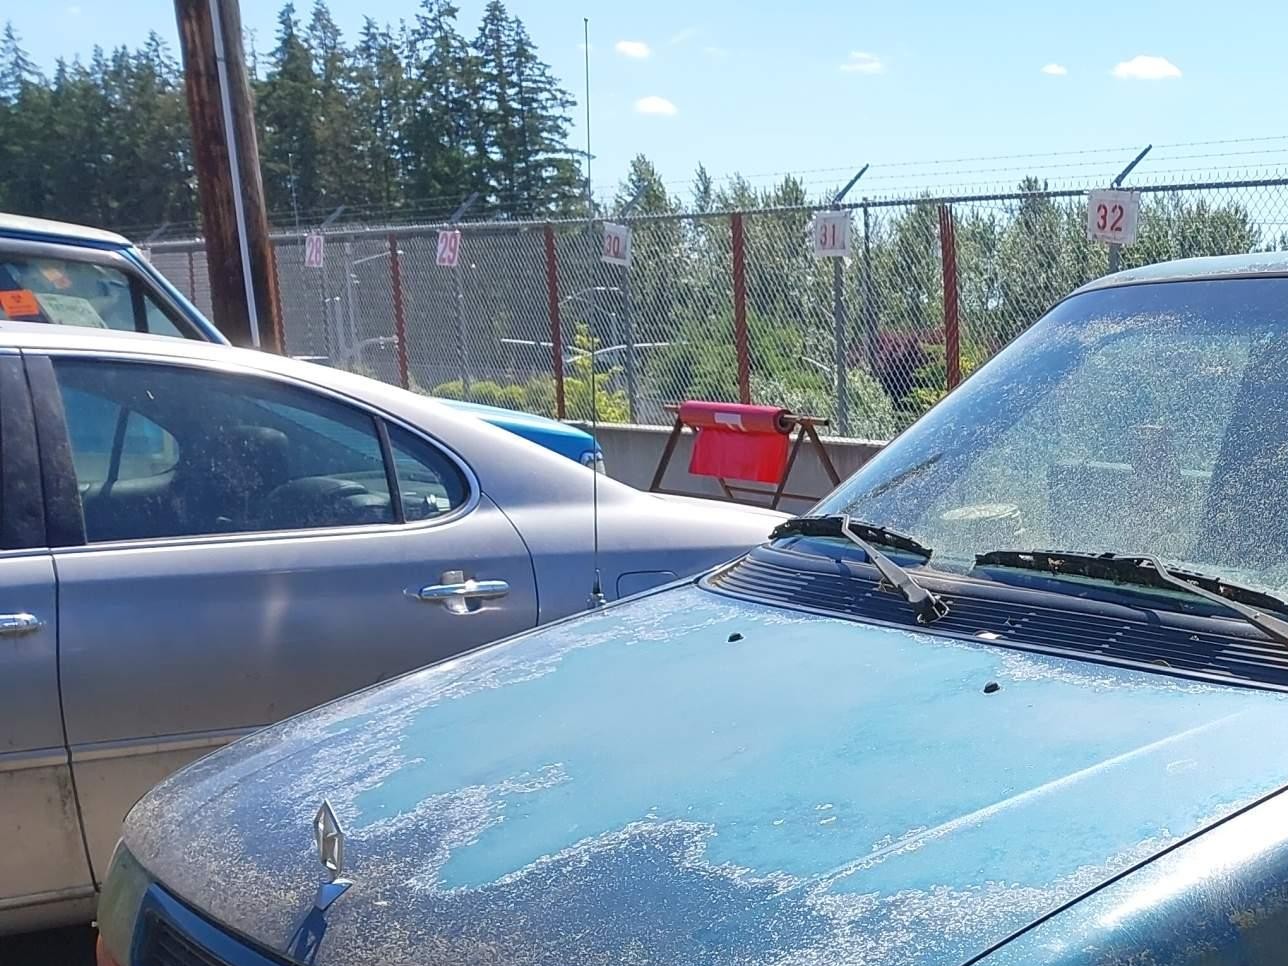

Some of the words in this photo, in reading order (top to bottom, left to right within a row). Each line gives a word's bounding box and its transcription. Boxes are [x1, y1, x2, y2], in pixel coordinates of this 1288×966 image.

[1096, 203, 1124, 232] 32
[439, 233, 459, 263] 29
[605, 234, 621, 257] 30
[820, 223, 836, 247] 31
[307, 236, 322, 264] 28
